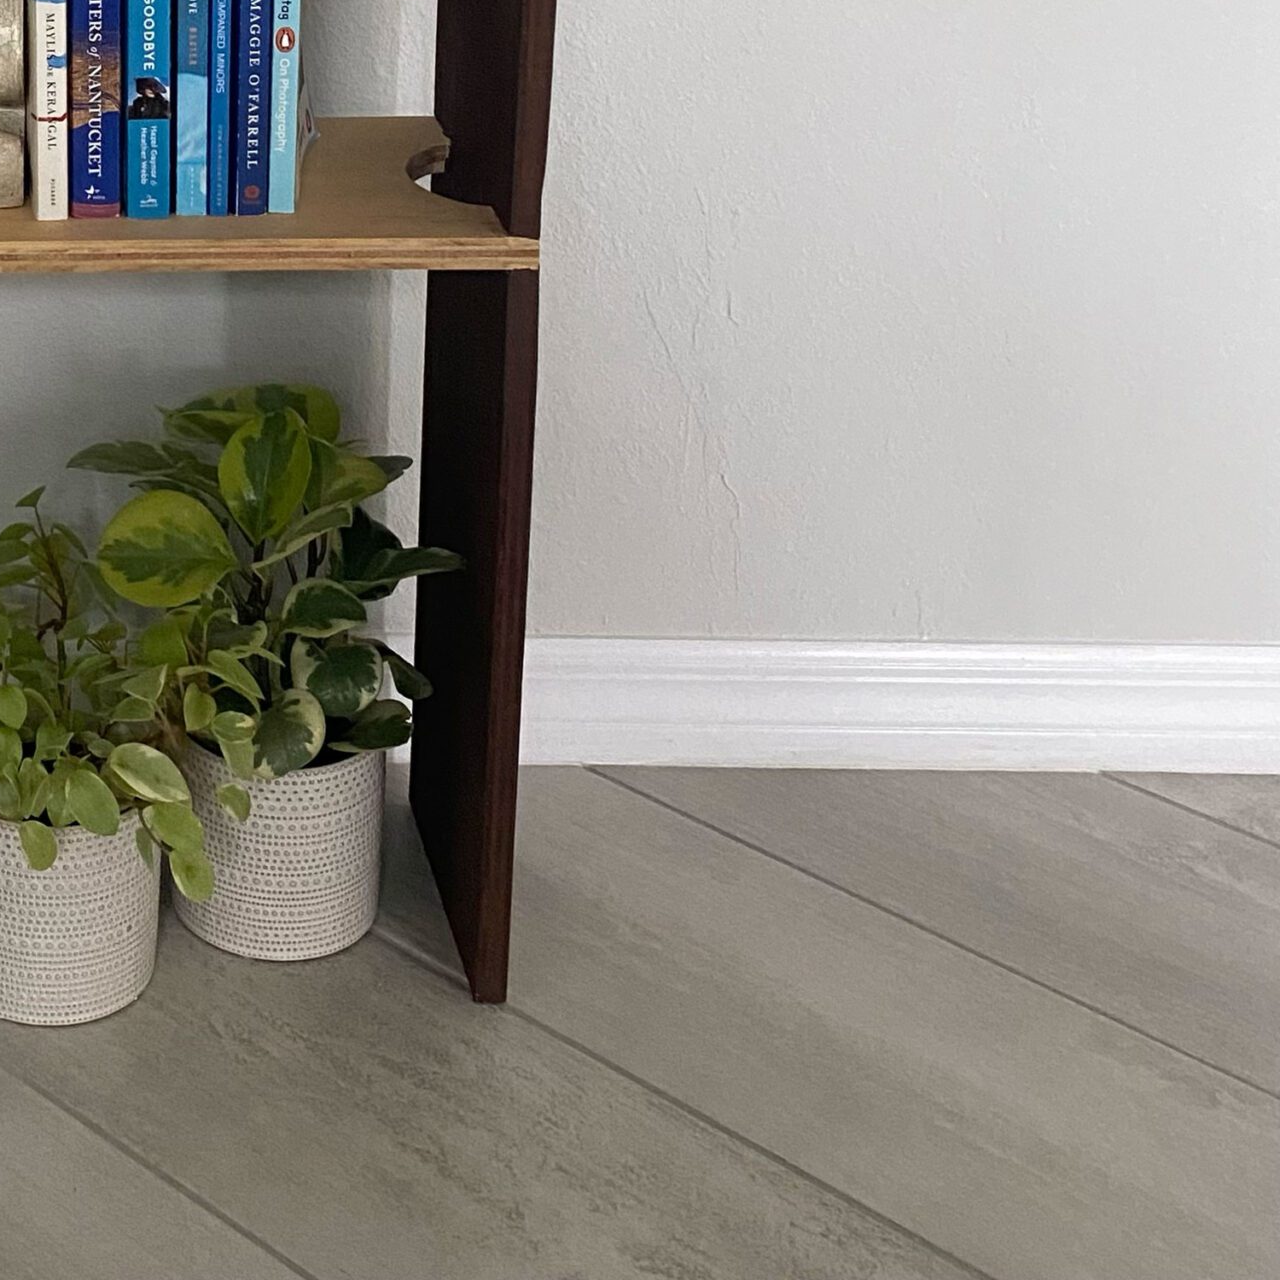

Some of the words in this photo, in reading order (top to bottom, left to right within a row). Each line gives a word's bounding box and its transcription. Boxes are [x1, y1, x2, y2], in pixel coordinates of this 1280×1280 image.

[45, 12, 56, 60] MAYLIS
[86, 46, 101, 60] of
[214, 52, 225, 93] MINORS
[279, 58, 289, 76] On
[87, 64, 102, 177] NANTUCKET
[246, 74, 260, 169] O'FARRELL
[273, 78, 289, 153] Photography
[139, 127, 148, 160] Heather
[150, 125, 158, 148] Hazel
[139, 161, 147, 185] Webb
